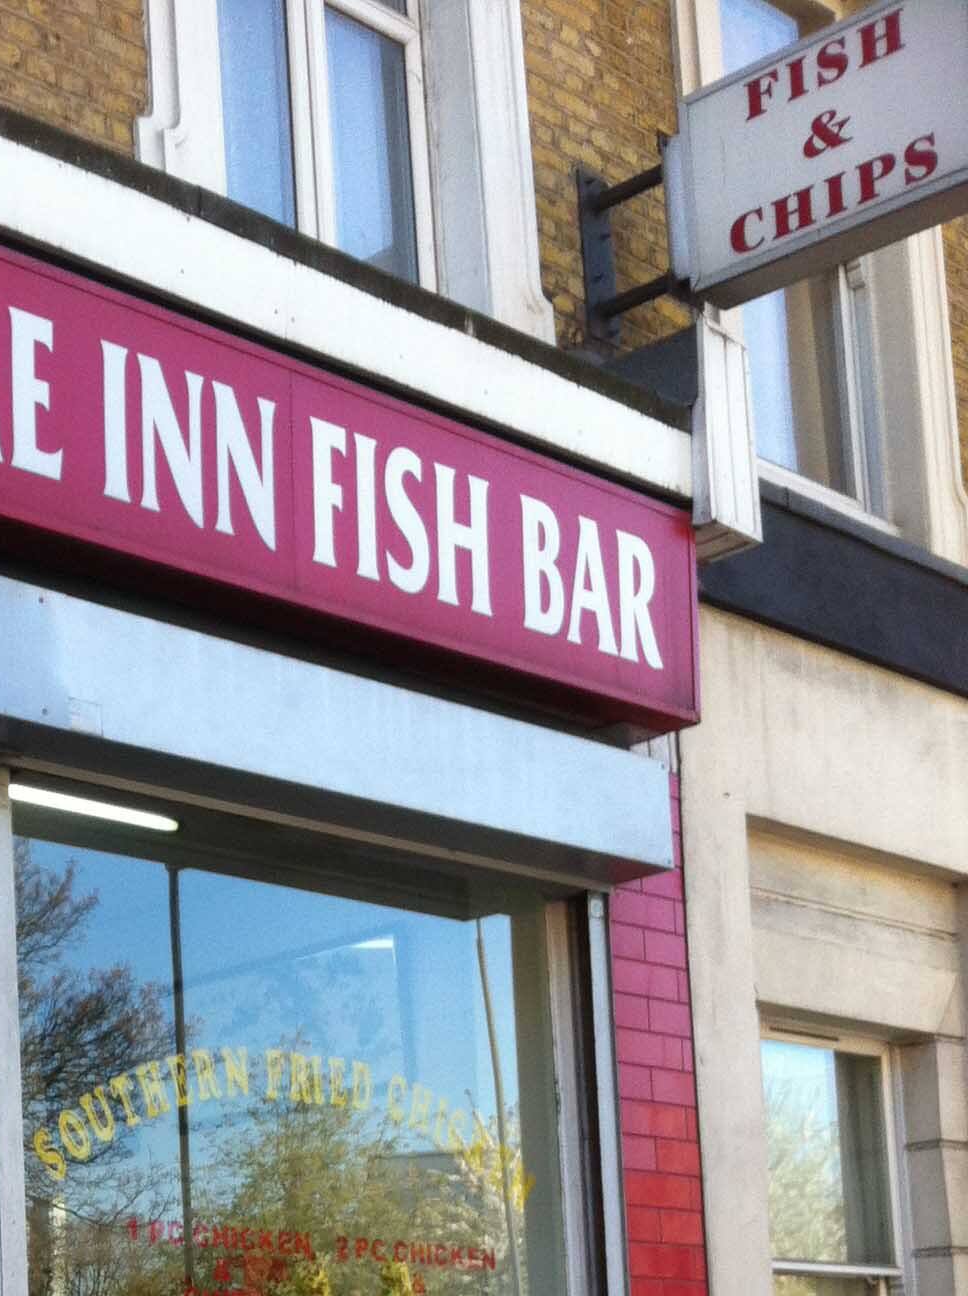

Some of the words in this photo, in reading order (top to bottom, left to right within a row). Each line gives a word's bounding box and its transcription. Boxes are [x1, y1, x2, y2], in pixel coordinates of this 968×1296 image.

[743, 8, 906, 122] FISH
[803, 109, 854, 159] &
[730, 132, 938, 254] CHIPS
[100, 339, 276, 551] INN
[310, 416, 493, 617] FISH
[520, 494, 663, 669] BAR
[33, 1046, 249, 1181] SOUTHERN
[266, 1048, 373, 1111] FRIED
[192, 1222, 316, 1262] CHICKEN
[392, 1241, 496, 1271] CHICKEN
